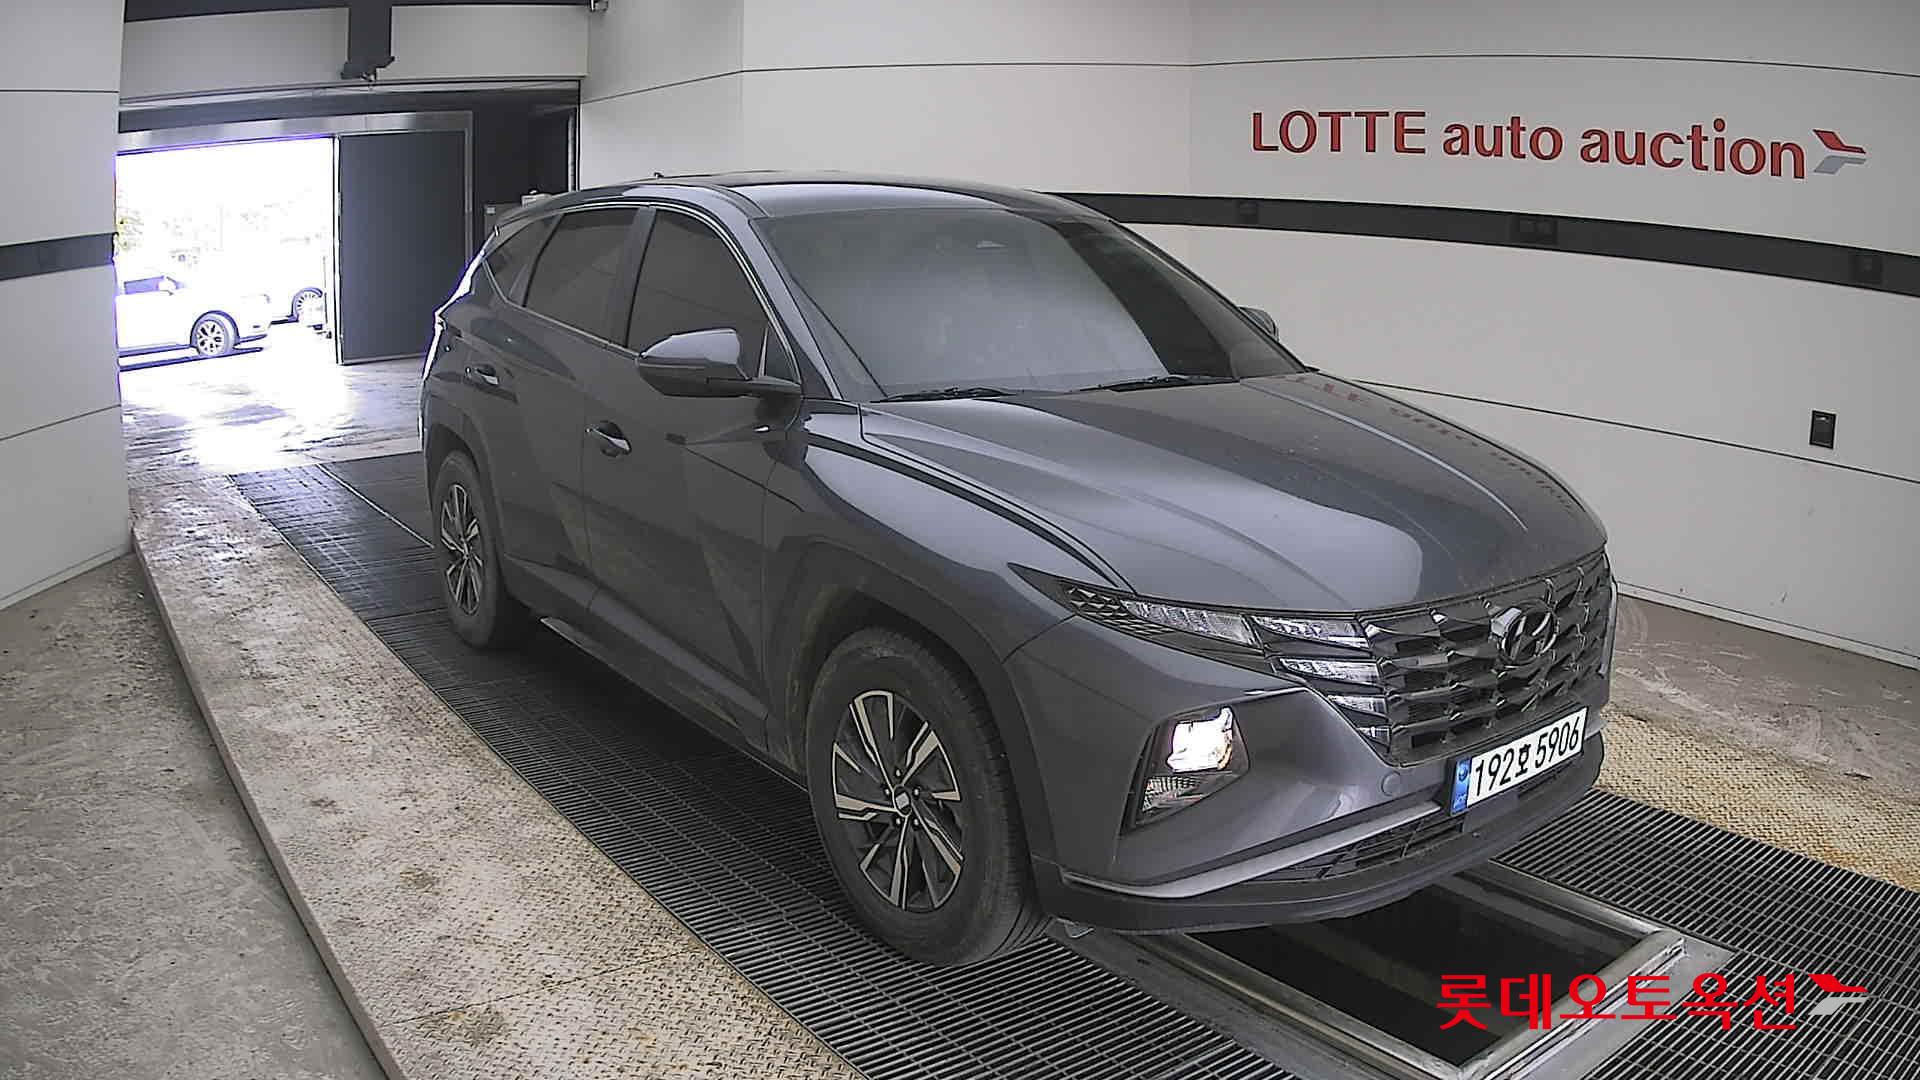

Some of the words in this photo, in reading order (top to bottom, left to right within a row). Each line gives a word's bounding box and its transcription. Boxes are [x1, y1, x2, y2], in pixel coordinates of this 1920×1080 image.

[1251, 110, 1426, 154] LOTTE
[1442, 115, 1564, 161] auto
[1580, 117, 1807, 179] auction
[1475, 743, 1532, 797] 192호
[1534, 716, 1580, 769] 5906
